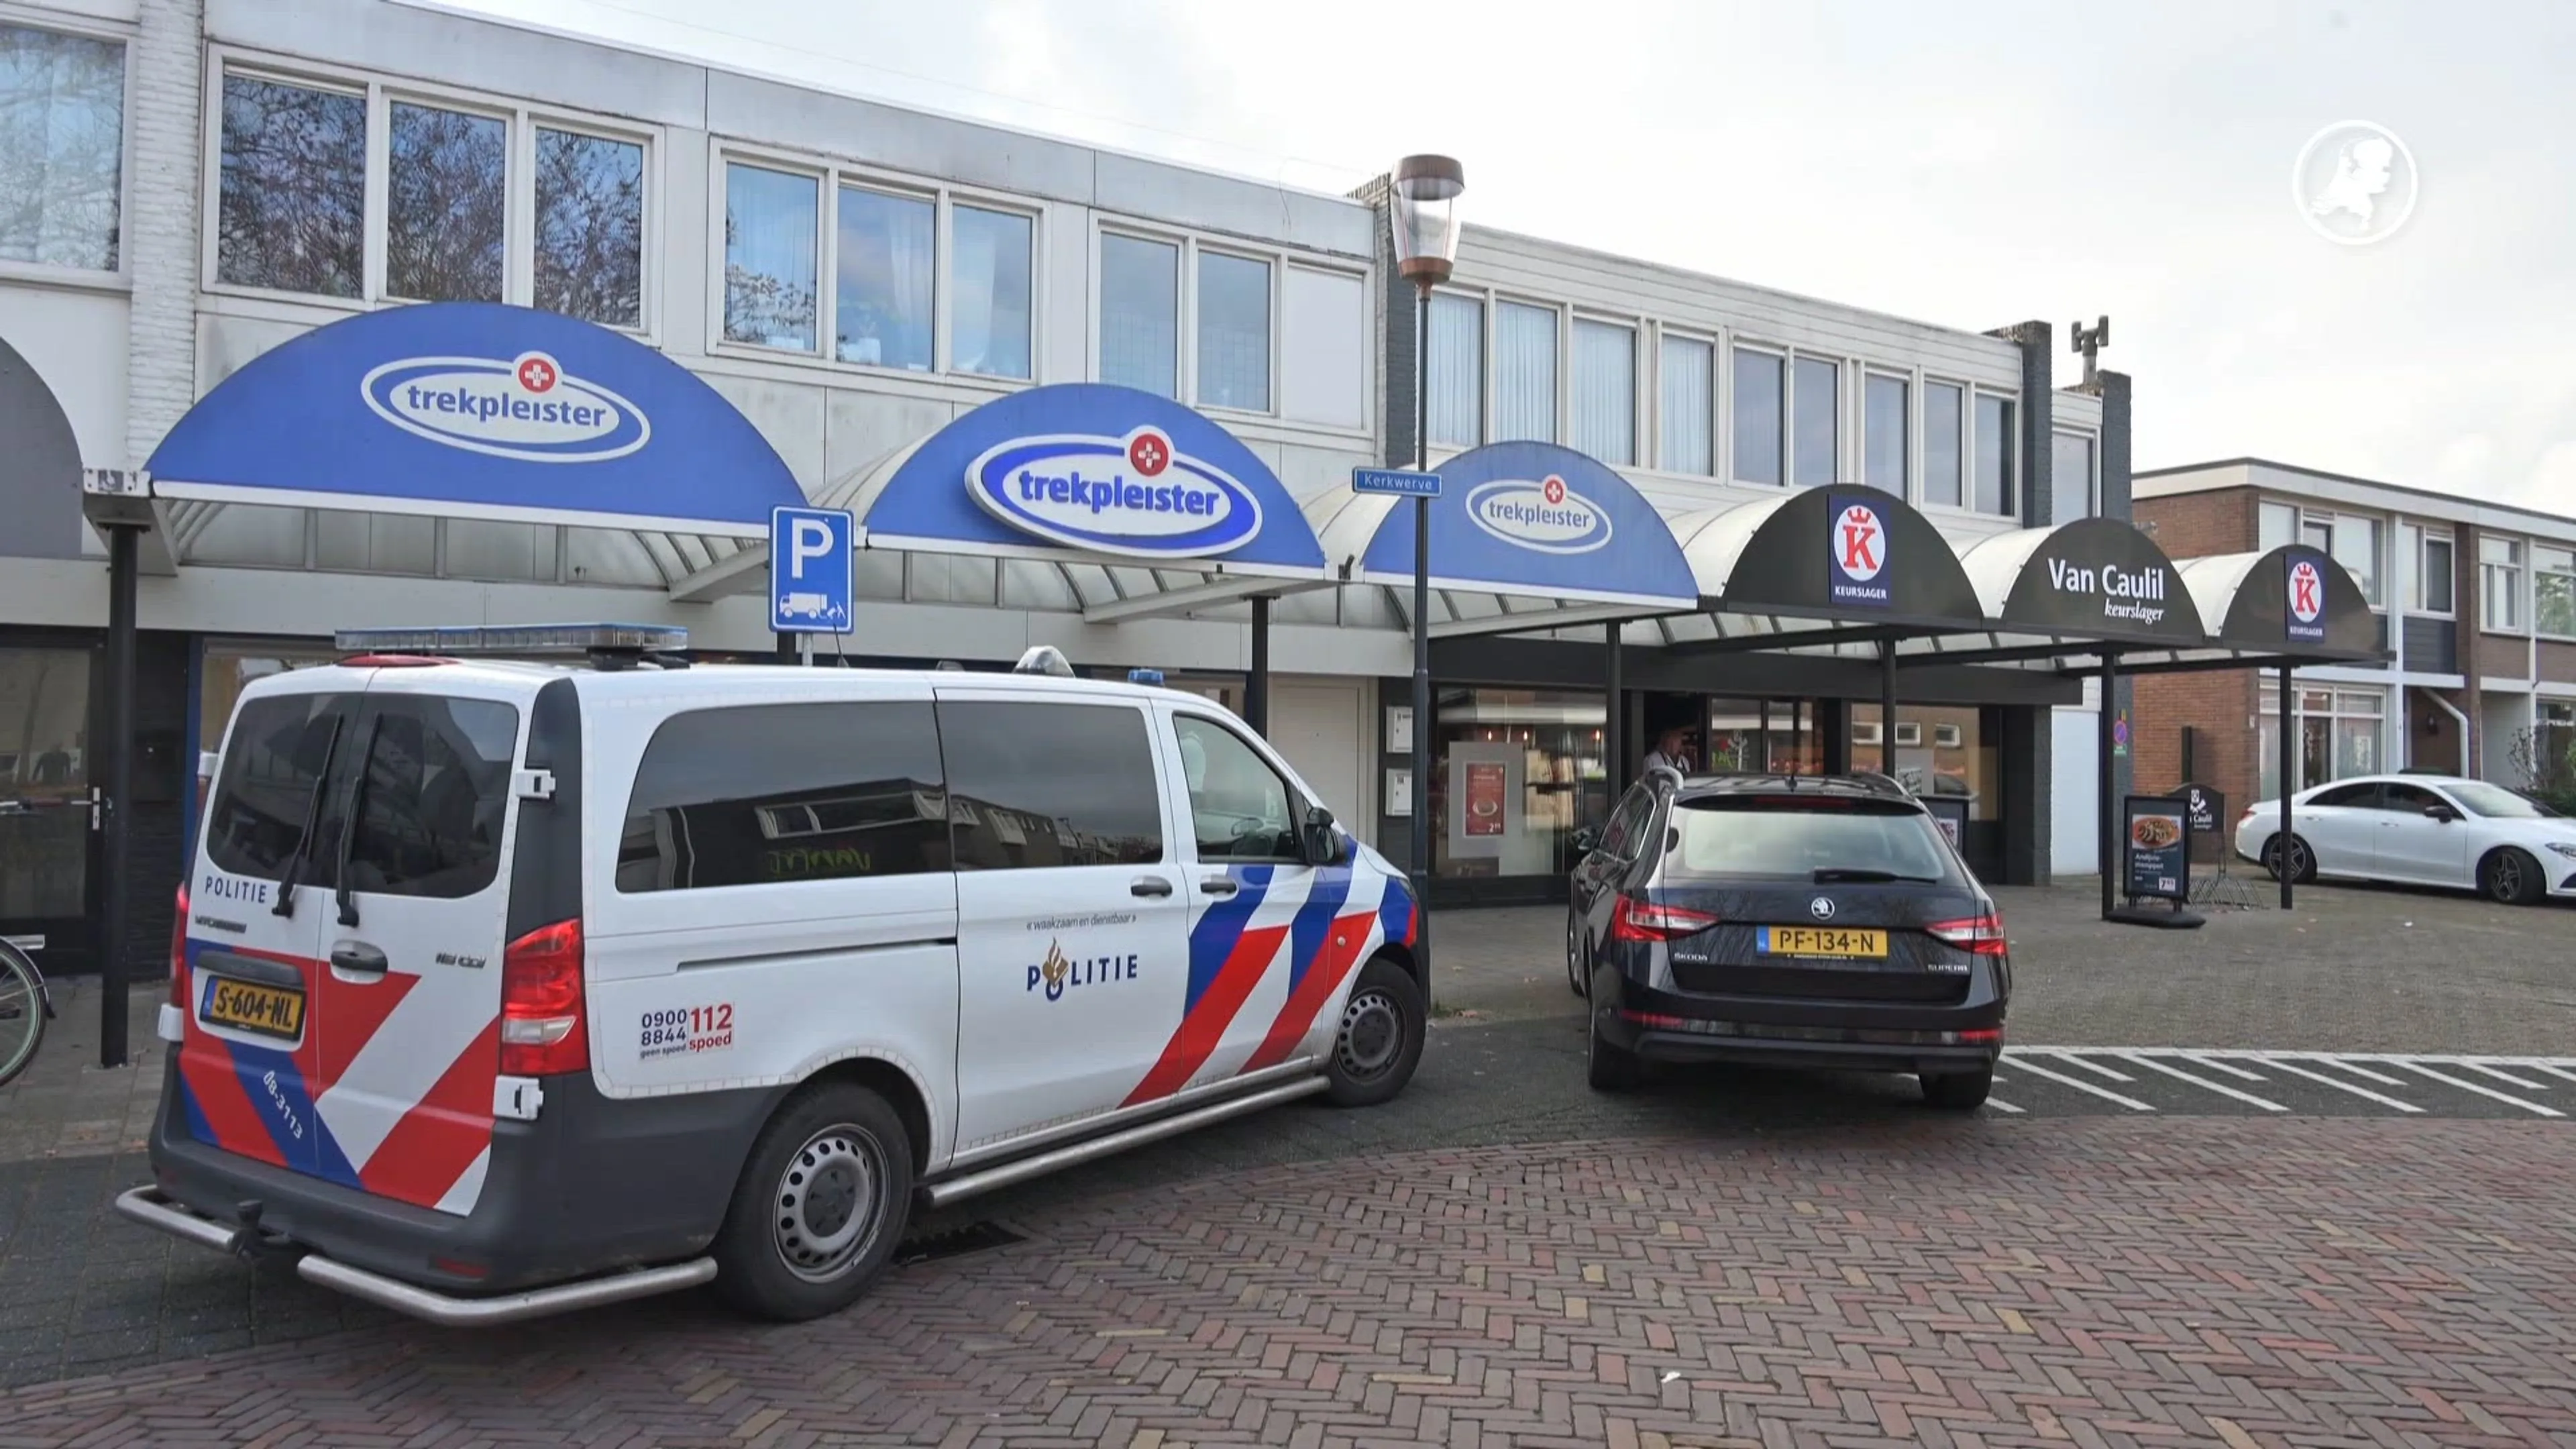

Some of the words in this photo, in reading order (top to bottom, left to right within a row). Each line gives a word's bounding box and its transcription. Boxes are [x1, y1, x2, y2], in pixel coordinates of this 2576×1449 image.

[408, 385, 606, 427] trekpleister
[1018, 470, 1220, 515] trekpleister
[1364, 473, 1432, 490] Kerkwerve
[1489, 500, 1590, 528] trekpleister
[792, 518, 834, 579] P
[1843, 525, 1877, 571] K
[1835, 586, 1887, 600] KEURSLAGER
[2048, 557, 2095, 594] Van
[2102, 564, 2164, 600] Caulil
[2295, 578, 2316, 614] K
[2104, 598, 2164, 625] keurslager
[205, 875, 267, 904] POLITIE
[1780, 930, 1874, 952] PF-134-N
[1027, 955, 1138, 1002] POLITIE
[215, 985, 293, 1028] S-604-NL
[641, 1009, 688, 1029] 0900
[690, 1004, 733, 1033] 112
[641, 1026, 687, 1046] 8844
[689, 1030, 733, 1053] spoed
[263, 1070, 303, 1138] 08-3113
